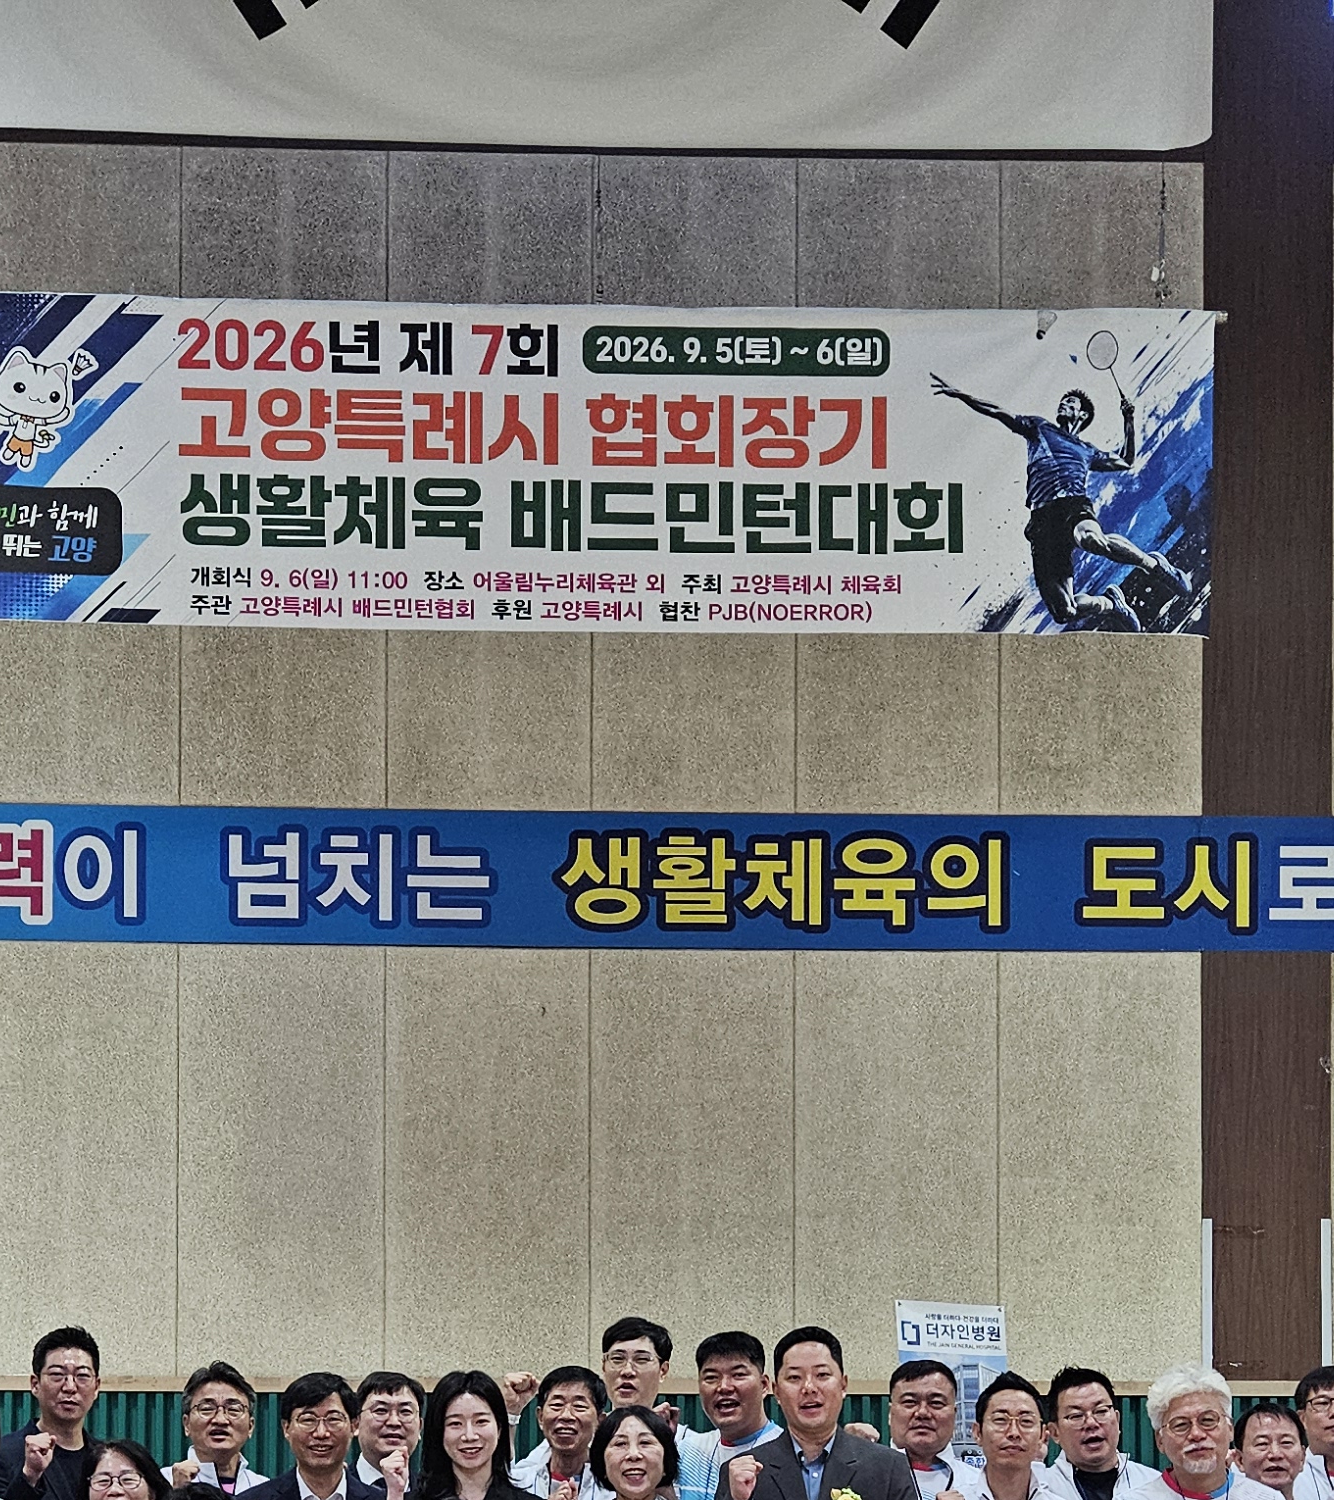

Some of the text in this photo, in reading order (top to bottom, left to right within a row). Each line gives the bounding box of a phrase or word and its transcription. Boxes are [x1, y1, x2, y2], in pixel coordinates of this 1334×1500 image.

[177, 318, 559, 378] 2026년 제 7회
[595, 335, 675, 363] 2026.
[683, 336, 707, 364] 9.
[715, 336, 782, 366] 5(토)
[817, 337, 883, 367] 6(일)
[177, 387, 888, 470] 고양특례시 협회장기
[47, 500, 99, 532] 함께
[180, 473, 964, 555] 생활체육 배드민턴대회
[2, 533, 43, 558] 뛰는
[47, 534, 98, 563] 고양
[190, 566, 902, 596] 개회식 9. 6(일) 11:00 장소 어울림누리체육관 외 주최 고양특례시 체육회
[189, 595, 873, 623] 주관 고양특례시 배드민턴협회 후원 고양특례시 협찬 PJB(NOERROR)
[228, 829, 494, 923] 넘치는
[559, 833, 1004, 928] 생활체육의
[926, 1322, 1001, 1342] 더자인병원
